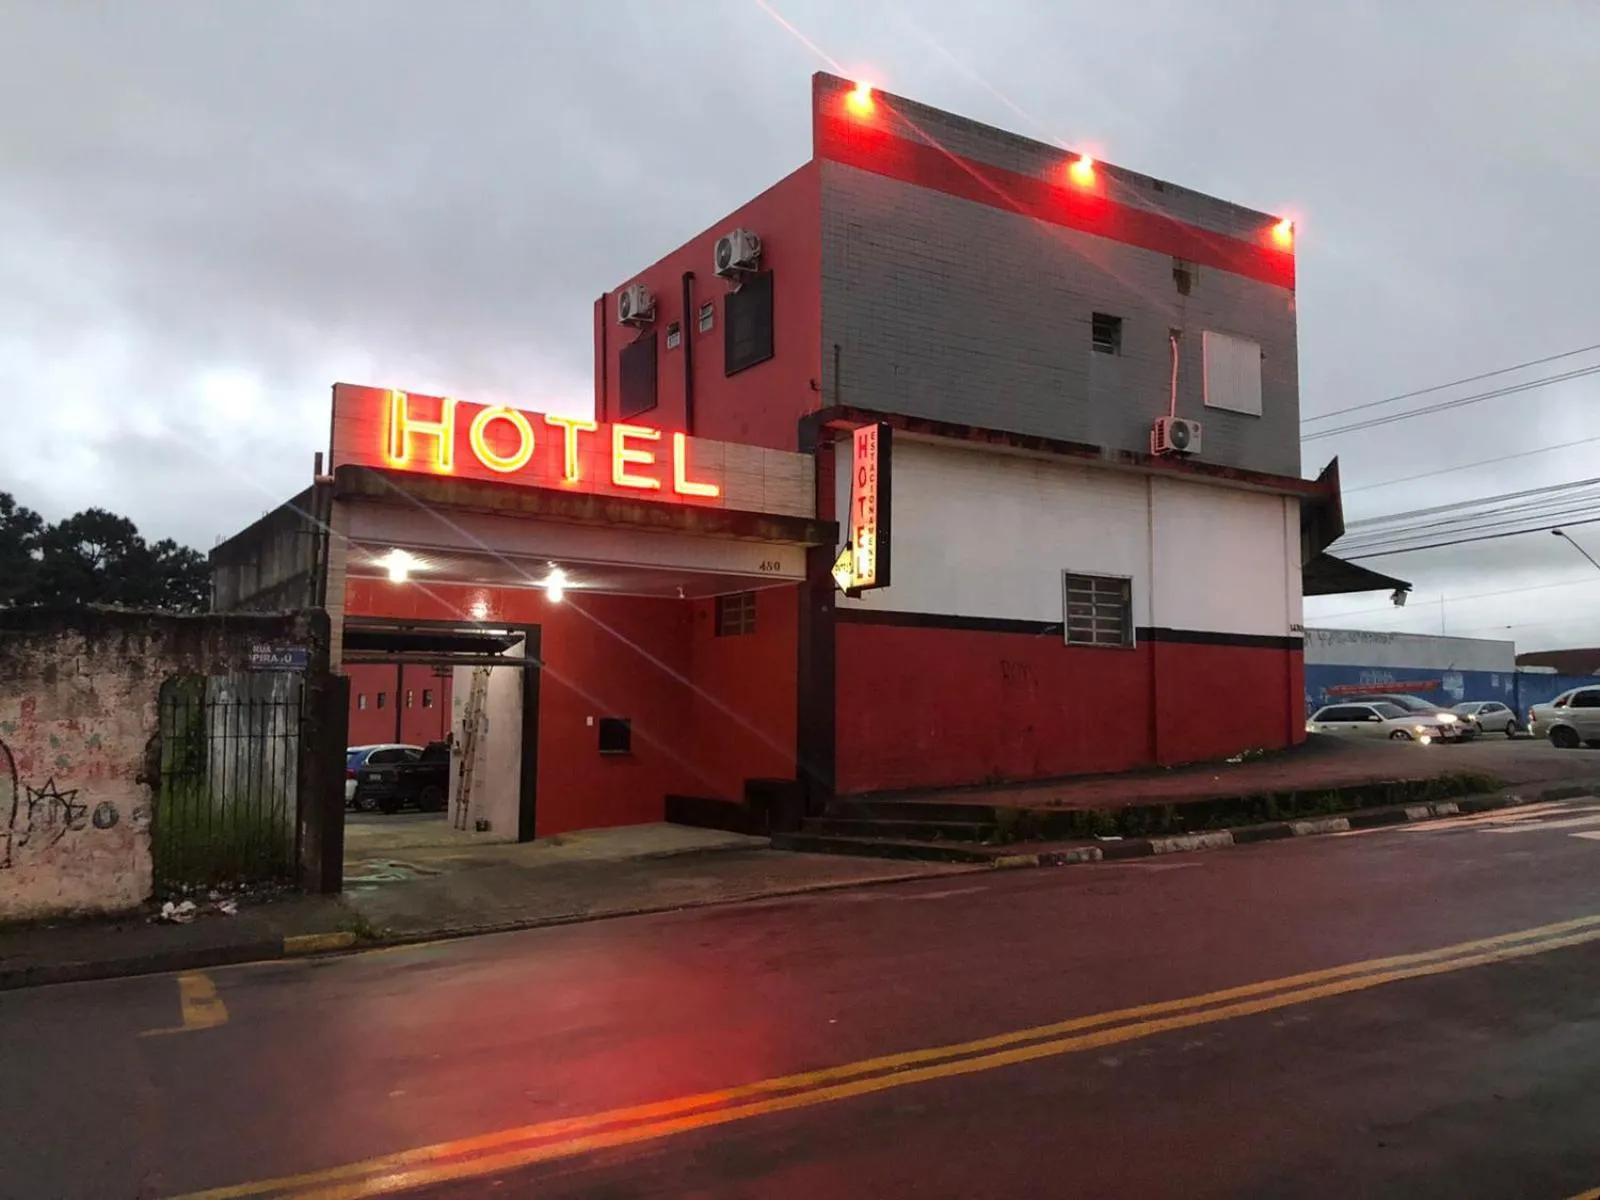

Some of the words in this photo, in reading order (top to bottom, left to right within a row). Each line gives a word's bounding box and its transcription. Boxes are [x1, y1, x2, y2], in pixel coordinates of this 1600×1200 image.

[388, 389, 720, 497] HOTEL
[857, 434, 868, 579] HOTEL
[867, 431, 876, 578] ESTACIONAMENTO
